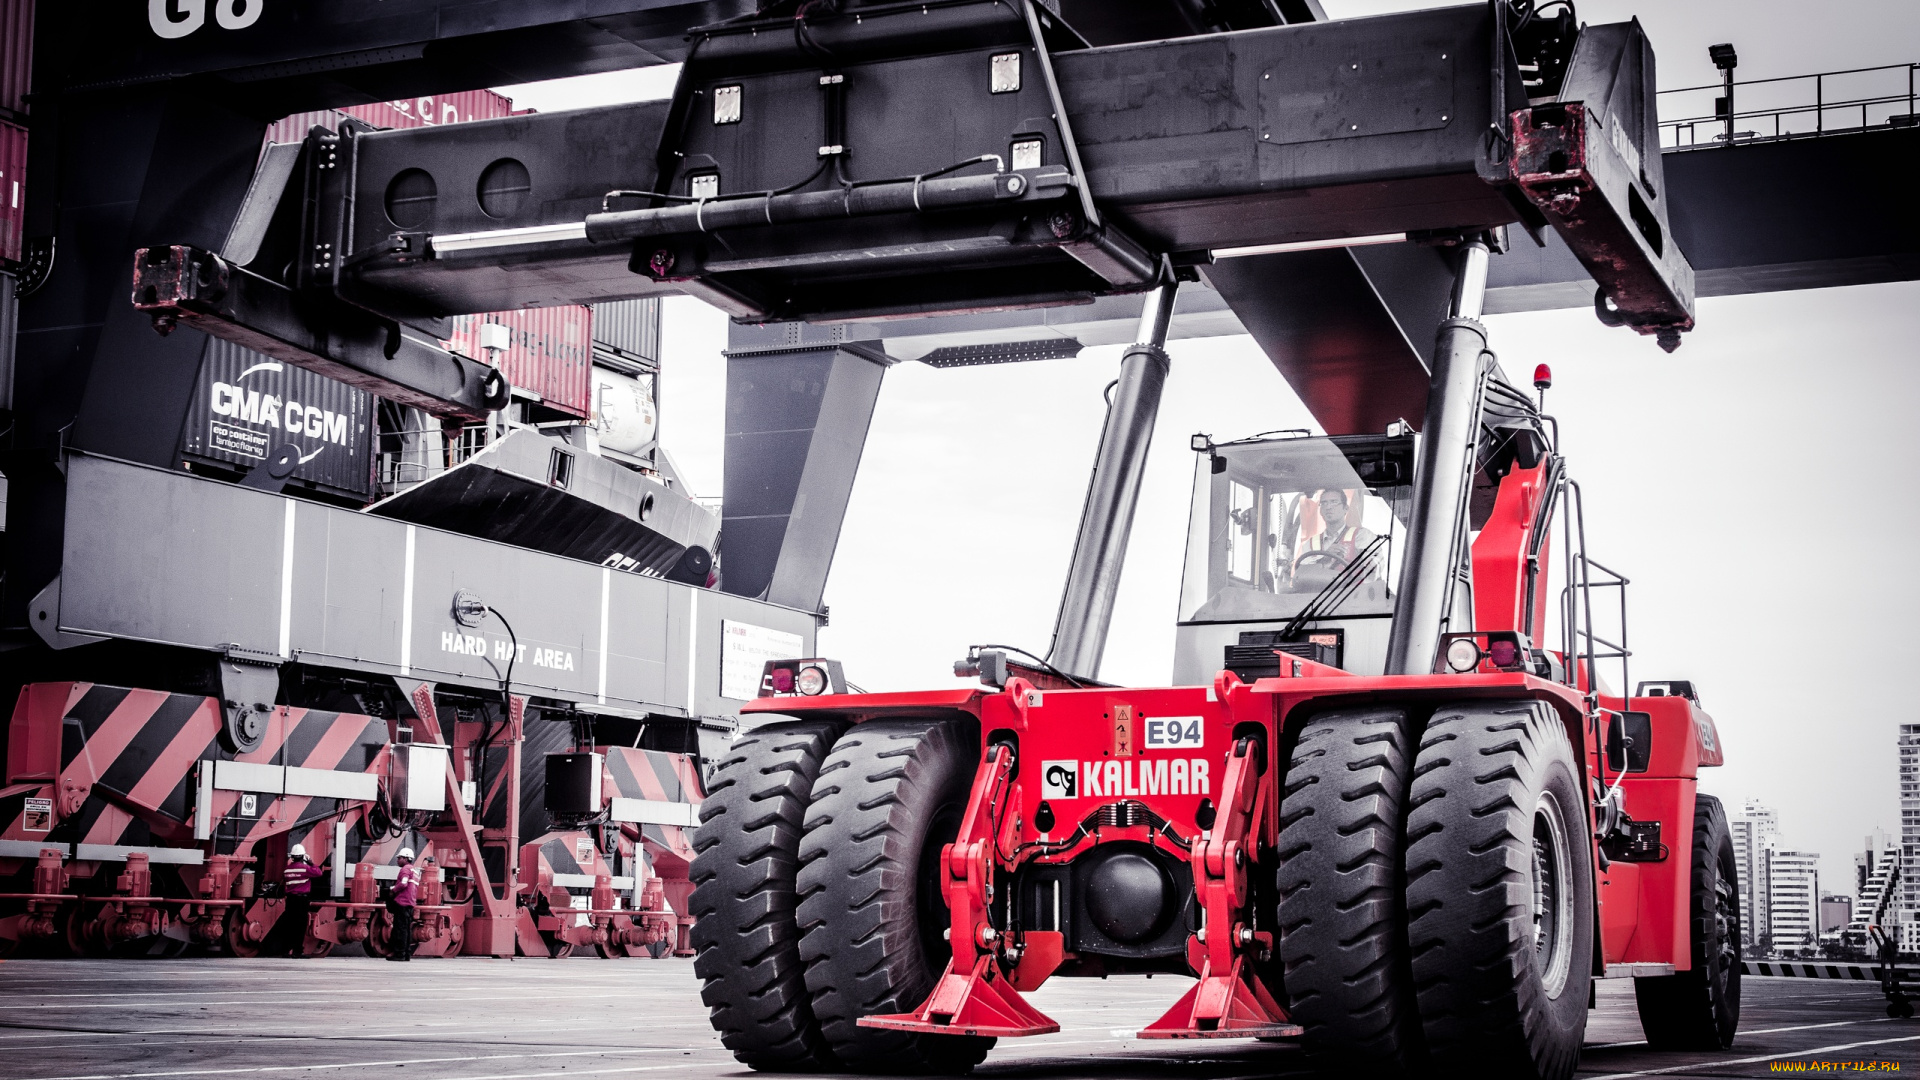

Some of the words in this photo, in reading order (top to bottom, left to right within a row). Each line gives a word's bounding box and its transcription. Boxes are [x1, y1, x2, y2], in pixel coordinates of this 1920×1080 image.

[211, 381, 280, 429] CMA
[284, 400, 348, 447] CGM
[213, 426, 228, 436] eco
[229, 430, 267, 446] container
[441, 631, 487, 657] HARD
[494, 640, 527, 663] HAT
[533, 647, 574, 672] AREA
[1148, 720, 1201, 745] E94
[1083, 758, 1210, 797] KALMAR
